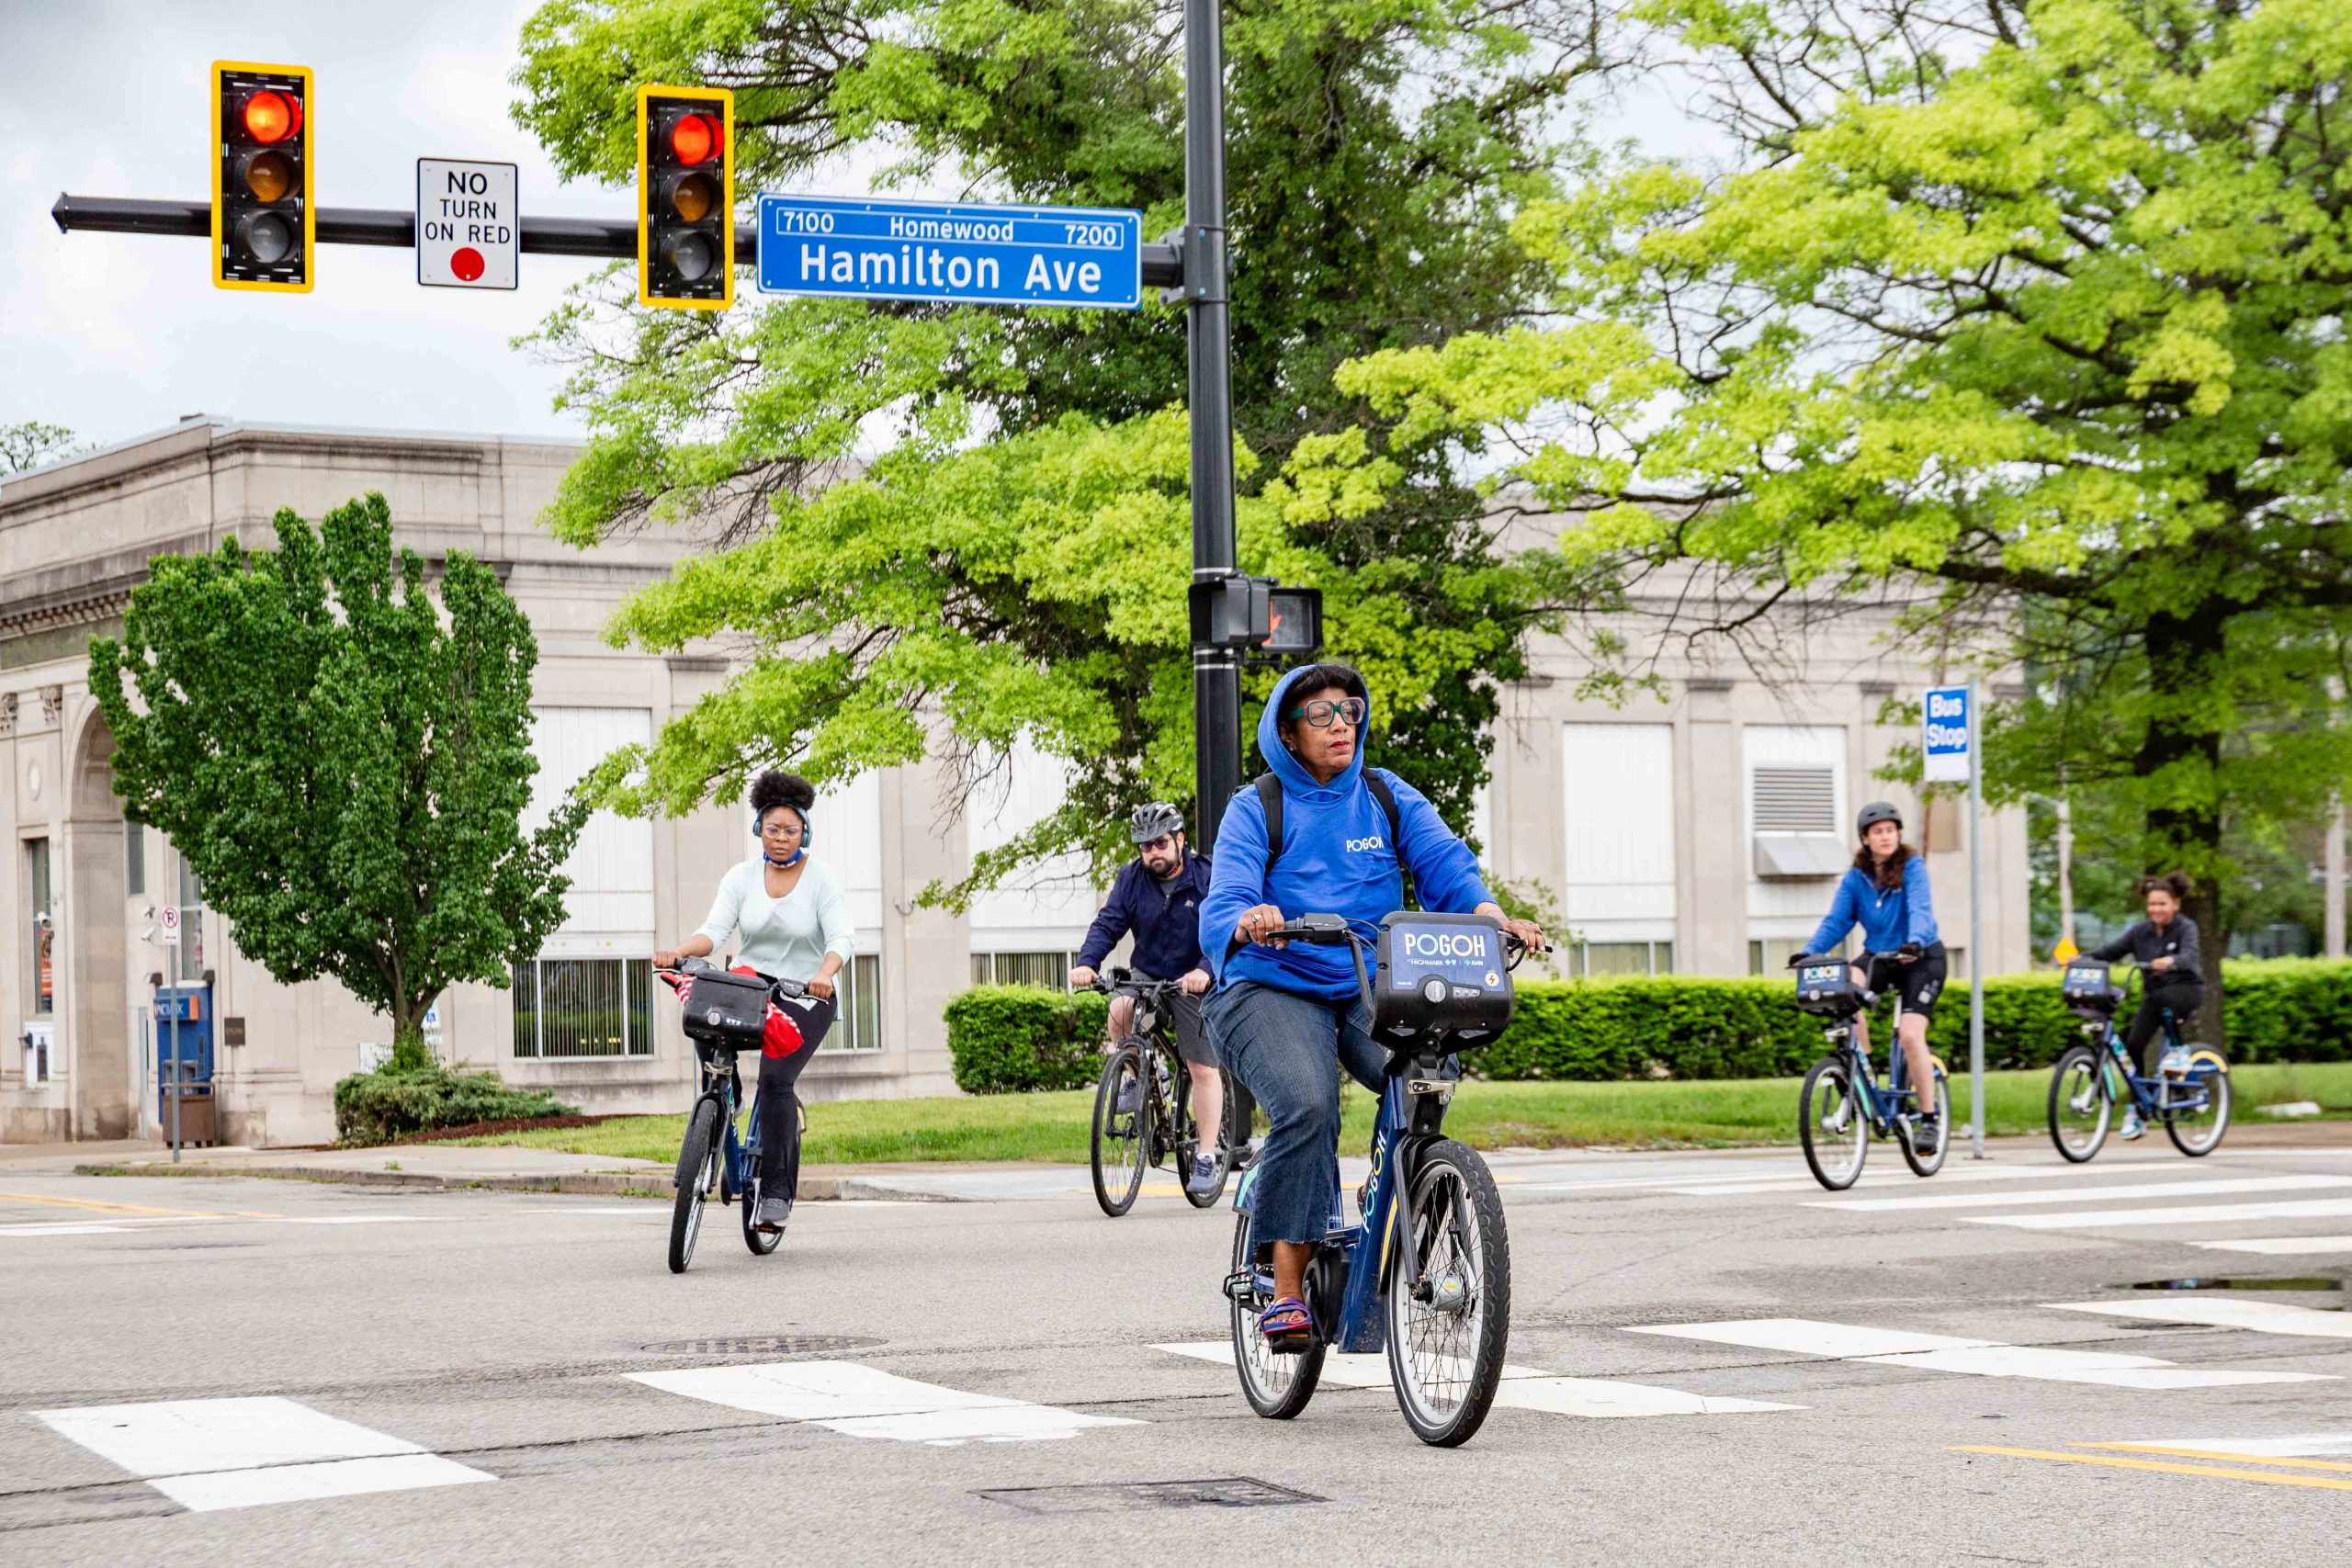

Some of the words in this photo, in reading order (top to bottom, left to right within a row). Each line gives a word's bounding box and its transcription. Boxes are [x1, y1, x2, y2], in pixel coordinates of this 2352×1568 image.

[447, 171, 488, 195] NO
[439, 198, 496, 220] TURN
[424, 221, 454, 241] ON
[468, 224, 511, 244] RED
[783, 210, 834, 234] 7100
[889, 216, 1014, 243] Homewood
[1064, 223, 1117, 247] 7200
[800, 243, 1001, 290] Hamilton
[1023, 253, 1102, 294] Ave
[1929, 694, 1963, 717] Bus
[1928, 723, 1967, 750] Stop
[1345, 836, 1385, 852] POGOH
[1404, 932, 1486, 957] POGOH
[1363, 1129, 1386, 1235] POGOH
